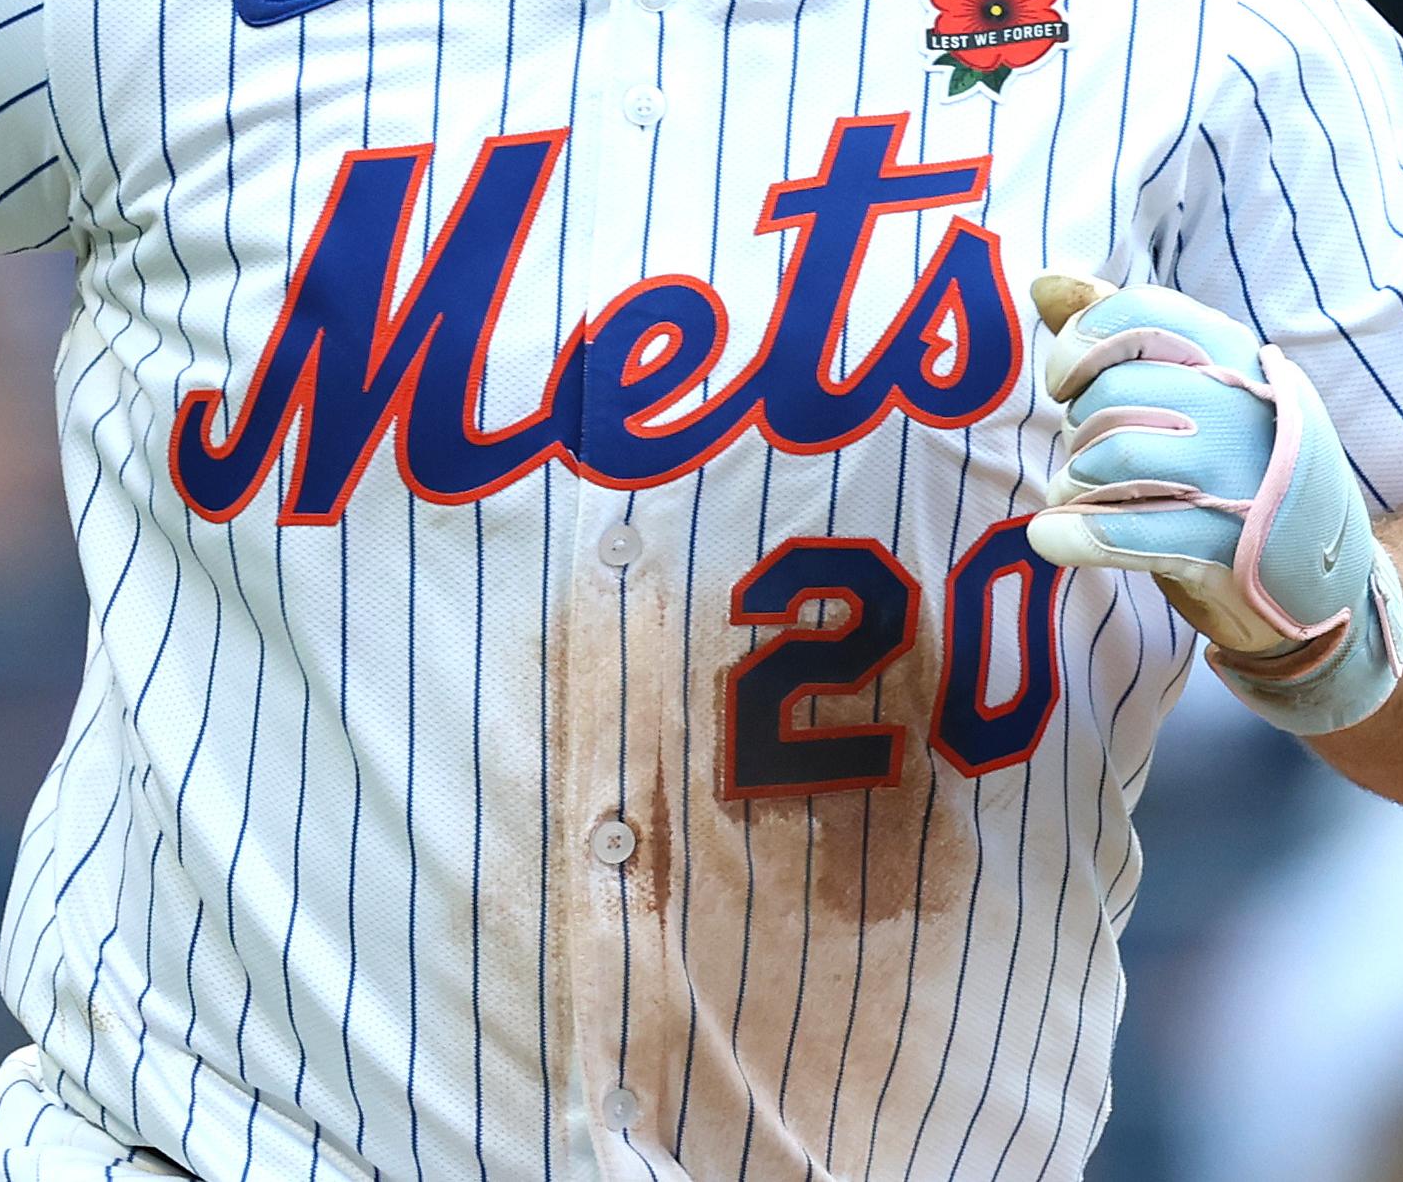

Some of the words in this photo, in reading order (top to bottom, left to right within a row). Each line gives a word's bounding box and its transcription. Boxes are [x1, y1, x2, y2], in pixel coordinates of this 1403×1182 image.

[931, 35, 970, 49] LEST
[974, 31, 998, 46] WE
[1003, 23, 1064, 41] FORGET
[169, 111, 1025, 527] Mets
[722, 513, 1064, 801] 20
